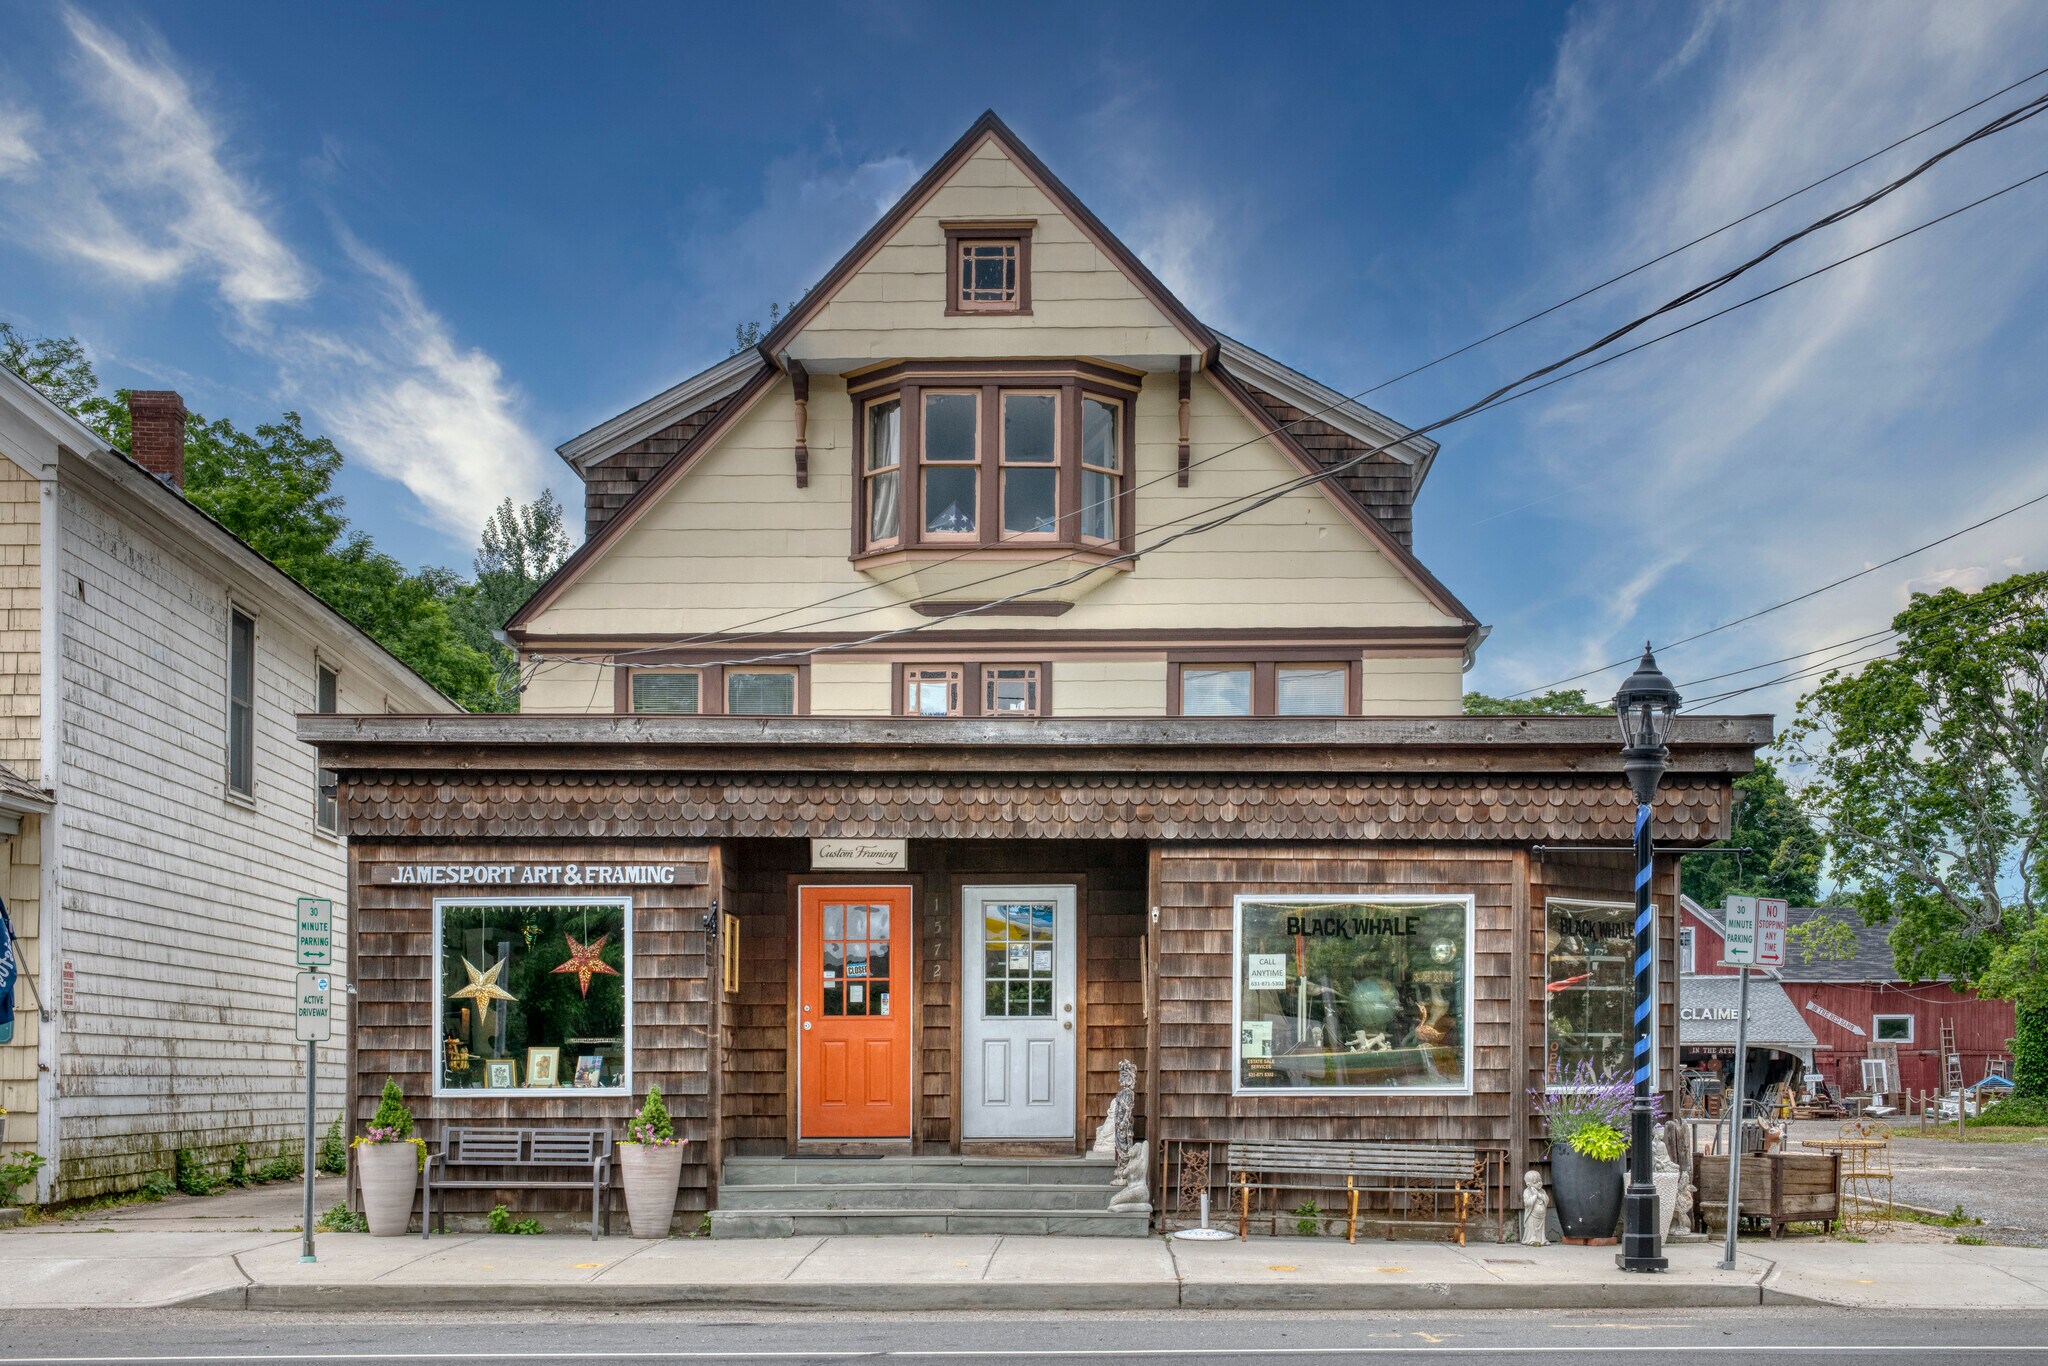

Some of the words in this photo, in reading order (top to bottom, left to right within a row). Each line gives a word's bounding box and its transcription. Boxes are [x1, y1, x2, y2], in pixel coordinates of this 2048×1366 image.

[819, 844, 854, 858] Custom
[855, 845, 899, 865] Framing
[391, 865, 515, 884] JAMESPORT
[309, 907, 318, 917] 30
[1736, 905, 1746, 915] 30
[1766, 905, 1778, 918] NO
[301, 922, 328, 931] MINUTE
[1287, 916, 1352, 939] BLACK
[1352, 916, 1420, 936] WHALE
[1560, 917, 1598, 941] BLACK
[1598, 920, 1635, 940] WHALE
[1728, 919, 1753, 929] MINUTE
[1758, 919, 1784, 930] STOPPING
[1726, 933, 1753, 944] PARKING
[1765, 931, 1777, 940] ANY
[300, 937, 329, 946] PARKING
[1764, 942, 1777, 952] TIME
[1258, 958, 1277, 966] CALL
[847, 965, 867, 975] CLOSE
[1251, 969, 1284, 977] ANYTIME
[303, 995, 324, 1005] ACTIVE
[298, 1007, 329, 1017] DRIVEWAY
[1680, 1008, 1751, 1020] CLAIME
[1818, 1008, 1830, 1017] THE
[1829, 1013, 1841, 1023] RED
